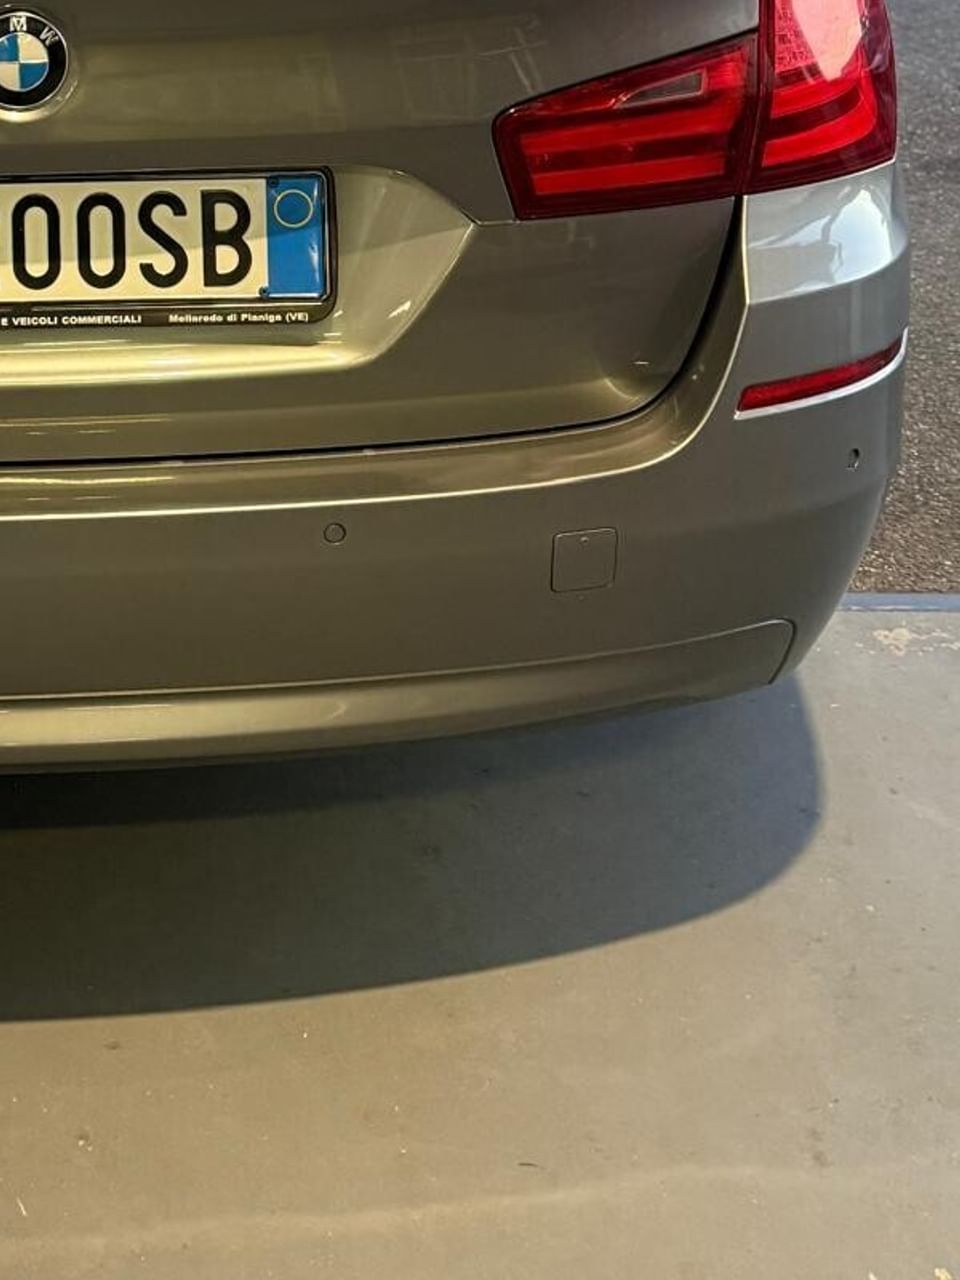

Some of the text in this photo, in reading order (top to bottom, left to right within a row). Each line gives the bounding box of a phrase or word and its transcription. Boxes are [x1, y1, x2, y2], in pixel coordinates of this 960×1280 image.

[1, 318, 8, 326] E
[12, 316, 58, 326] VEICOLI
[62, 315, 142, 325] COMMERCIALI
[227, 313, 237, 322] di
[241, 312, 282, 323] Pianiga
[286, 311, 309, 322] (VE)
